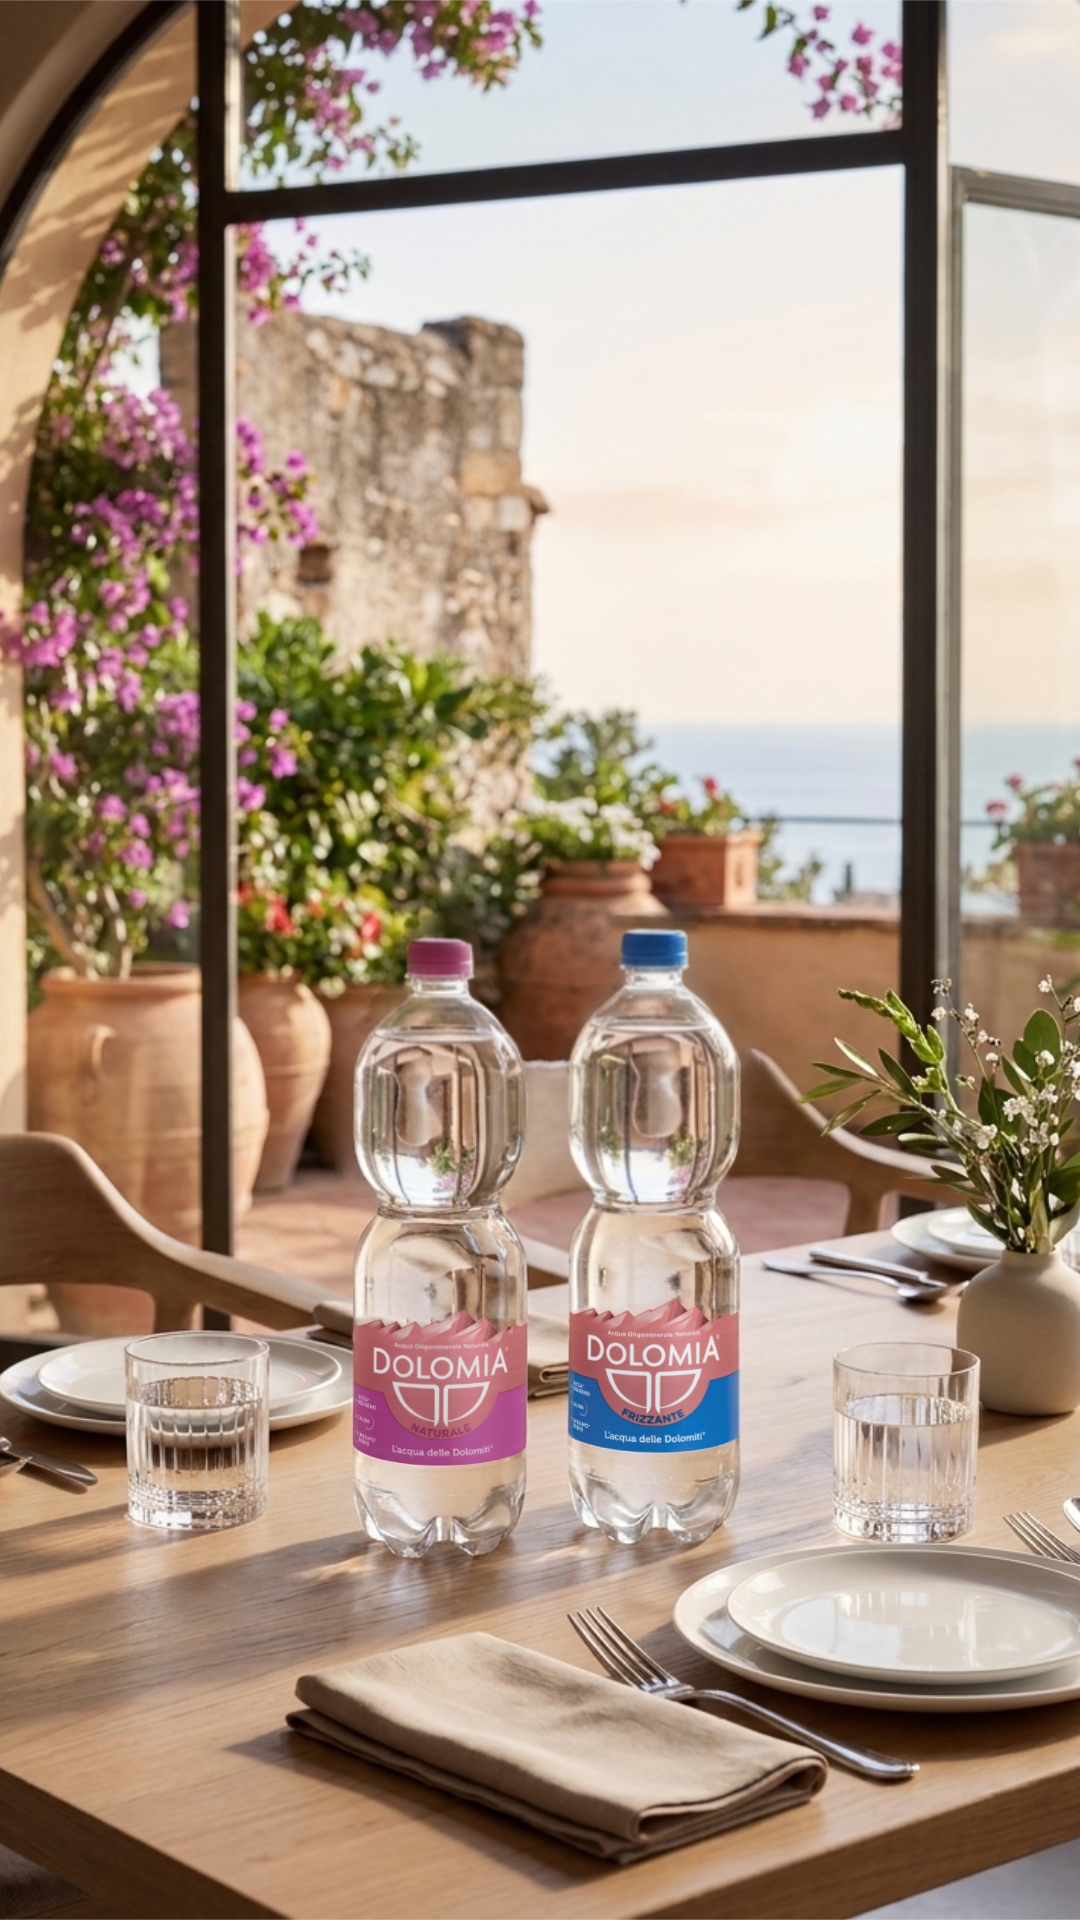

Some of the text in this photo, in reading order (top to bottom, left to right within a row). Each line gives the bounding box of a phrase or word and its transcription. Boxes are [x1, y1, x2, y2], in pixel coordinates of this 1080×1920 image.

[675, 1330, 701, 1338] Naturale
[414, 1343, 461, 1351] Oligominerale
[463, 1341, 490, 1349] Naturale
[587, 1334, 720, 1367] DOLOMIA
[373, 1347, 508, 1380] DOLOMIA
[621, 1407, 685, 1424] FRIZZANTE
[410, 1422, 472, 1438] NATURALE
[639, 1434, 662, 1443] delle
[427, 1448, 450, 1457] delle
